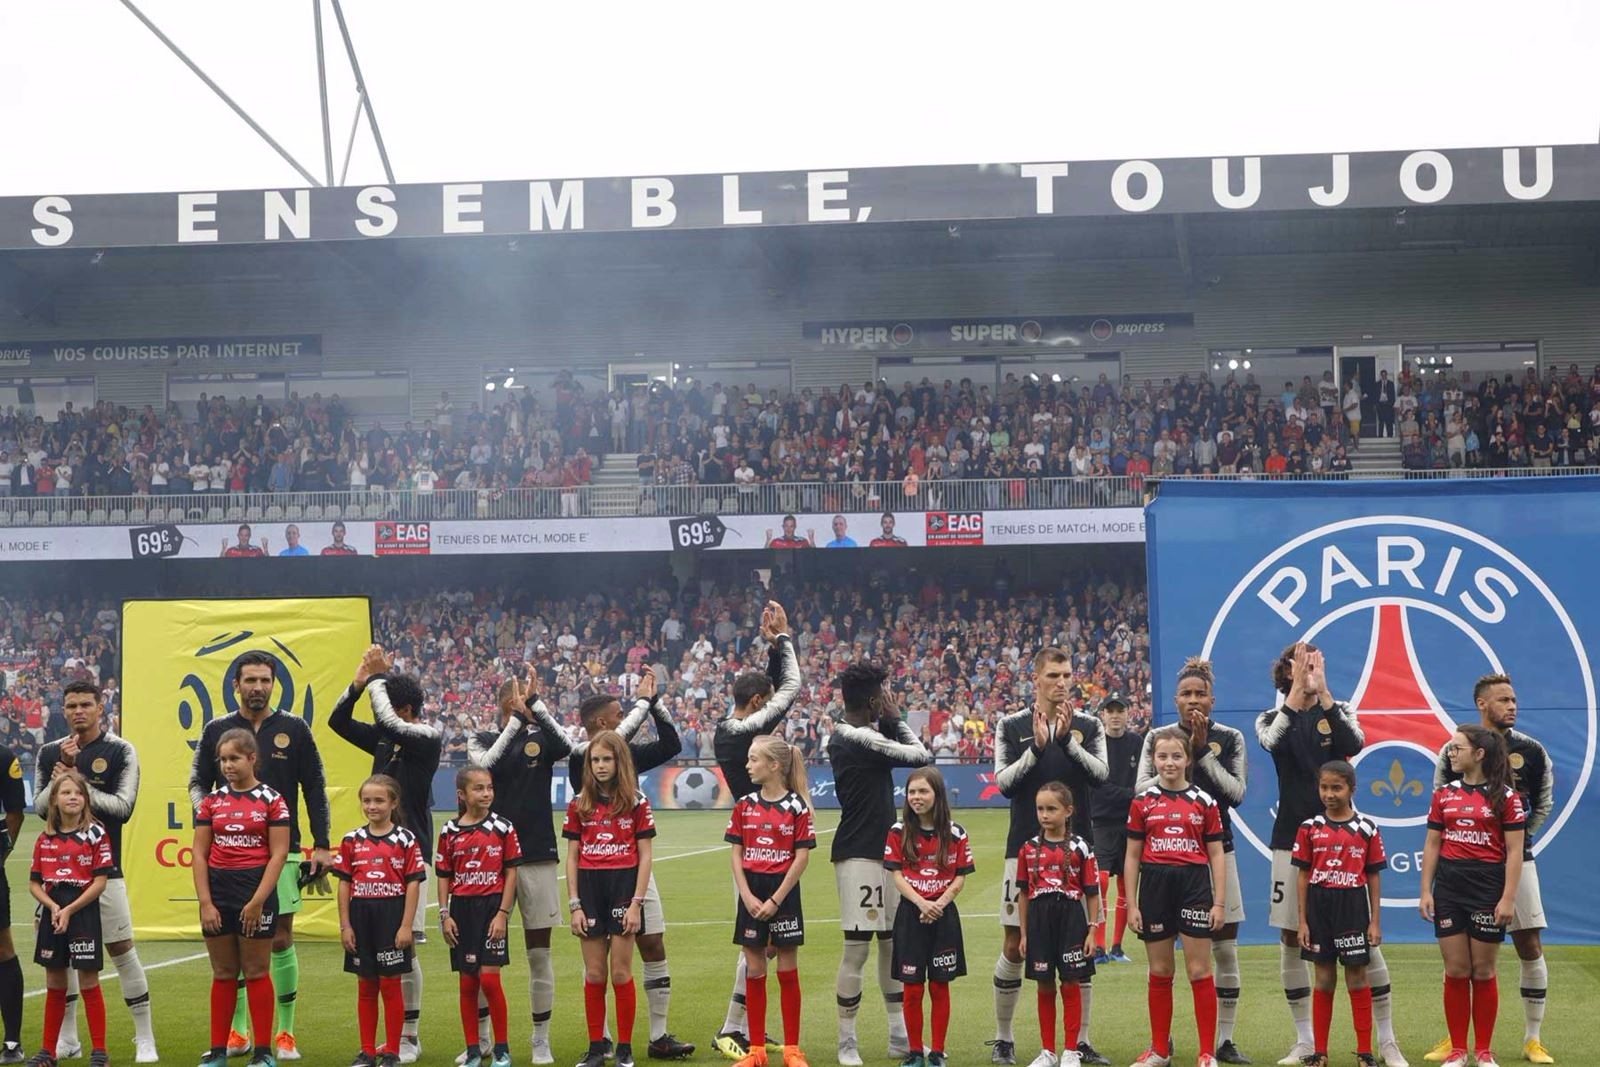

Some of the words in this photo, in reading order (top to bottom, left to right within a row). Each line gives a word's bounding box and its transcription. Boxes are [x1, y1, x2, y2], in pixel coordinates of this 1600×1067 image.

[821, 327, 888, 345] HYPER
[950, 324, 1017, 341] SUPER
[1115, 321, 1166, 335] express
[53, 348, 86, 361] VOS
[92, 345, 169, 361] COURSES
[176, 344, 209, 359] PAR
[216, 342, 302, 358] INTERNET
[948, 514, 981, 531] EAG
[990, 525, 1035, 535] TENUES
[1037, 525, 1053, 535] DE
[1057, 523, 1099, 535] MATCH,
[1102, 522, 1136, 533] MODE
[396, 523, 428, 541] EAG
[436, 534, 480, 545] TENUES
[482, 534, 498, 544] DE
[500, 533, 541, 544] MATCH,
[544, 533, 576, 543] MODE
[9, 541, 40, 551] MODE
[1257, 536, 1520, 627] PARIS
[155, 838, 194, 868] Co
[1151, 836, 1200, 853] SERVAGROUPE
[860, 885, 884, 908] 21
[1273, 881, 1285, 904] 5
